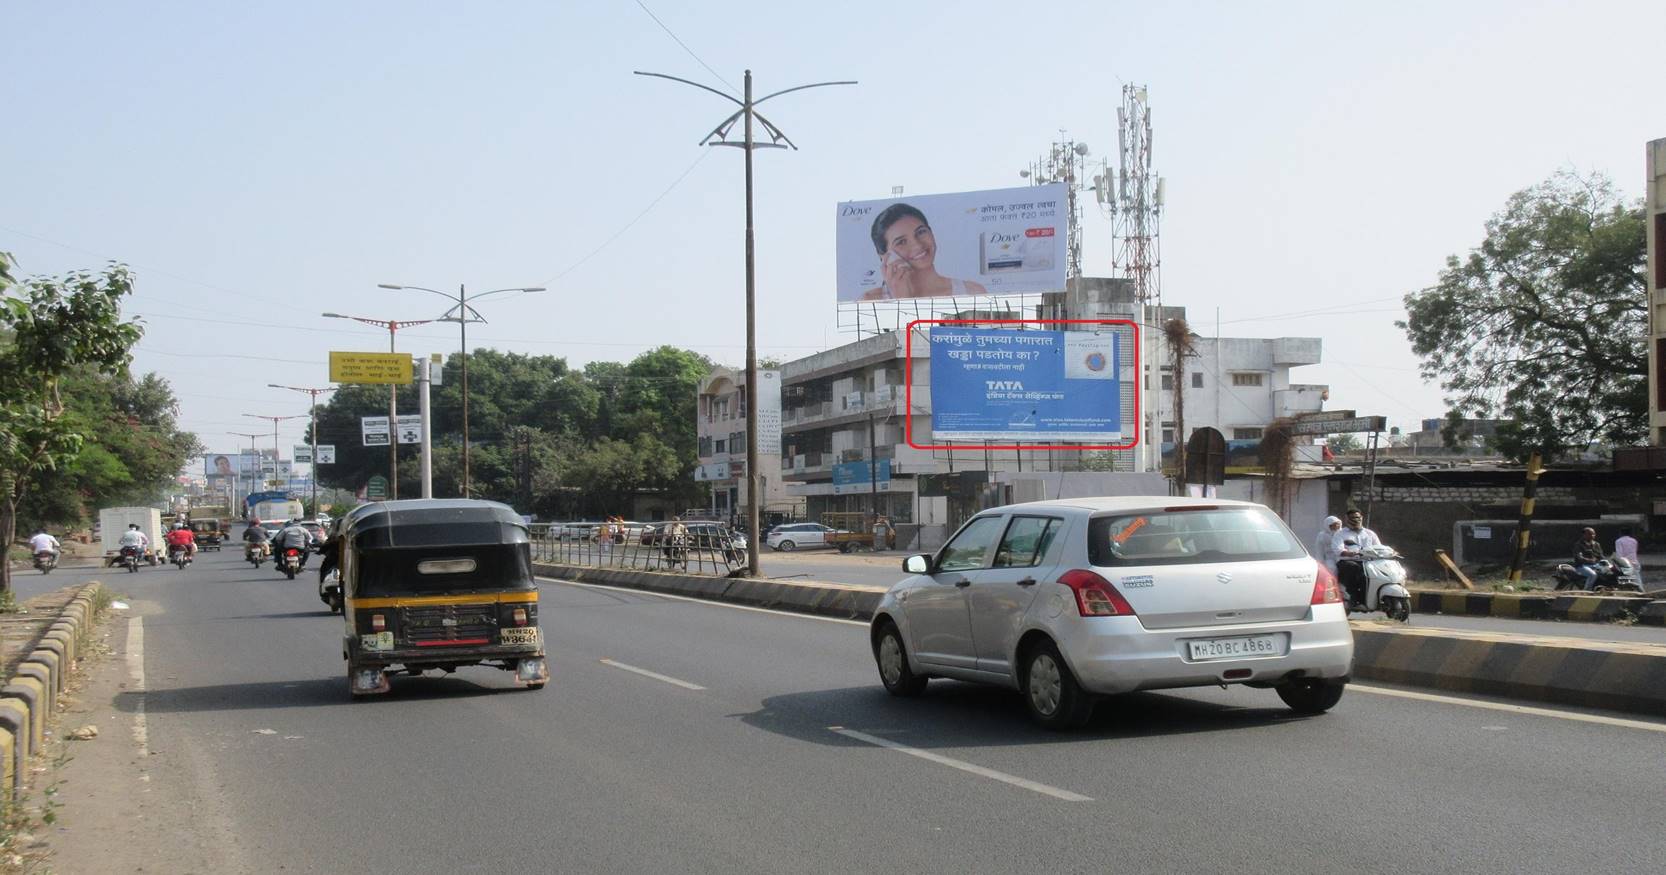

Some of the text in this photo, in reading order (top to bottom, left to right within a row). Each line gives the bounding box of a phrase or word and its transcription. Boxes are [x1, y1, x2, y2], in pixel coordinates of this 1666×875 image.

[842, 205, 872, 216] Dove
[990, 231, 1020, 243] Dove
[976, 335, 1011, 346] तुमच्या
[1016, 336, 1053, 346] पगारात
[976, 348, 1013, 360] पडतोय
[985, 381, 1023, 391] TATA
